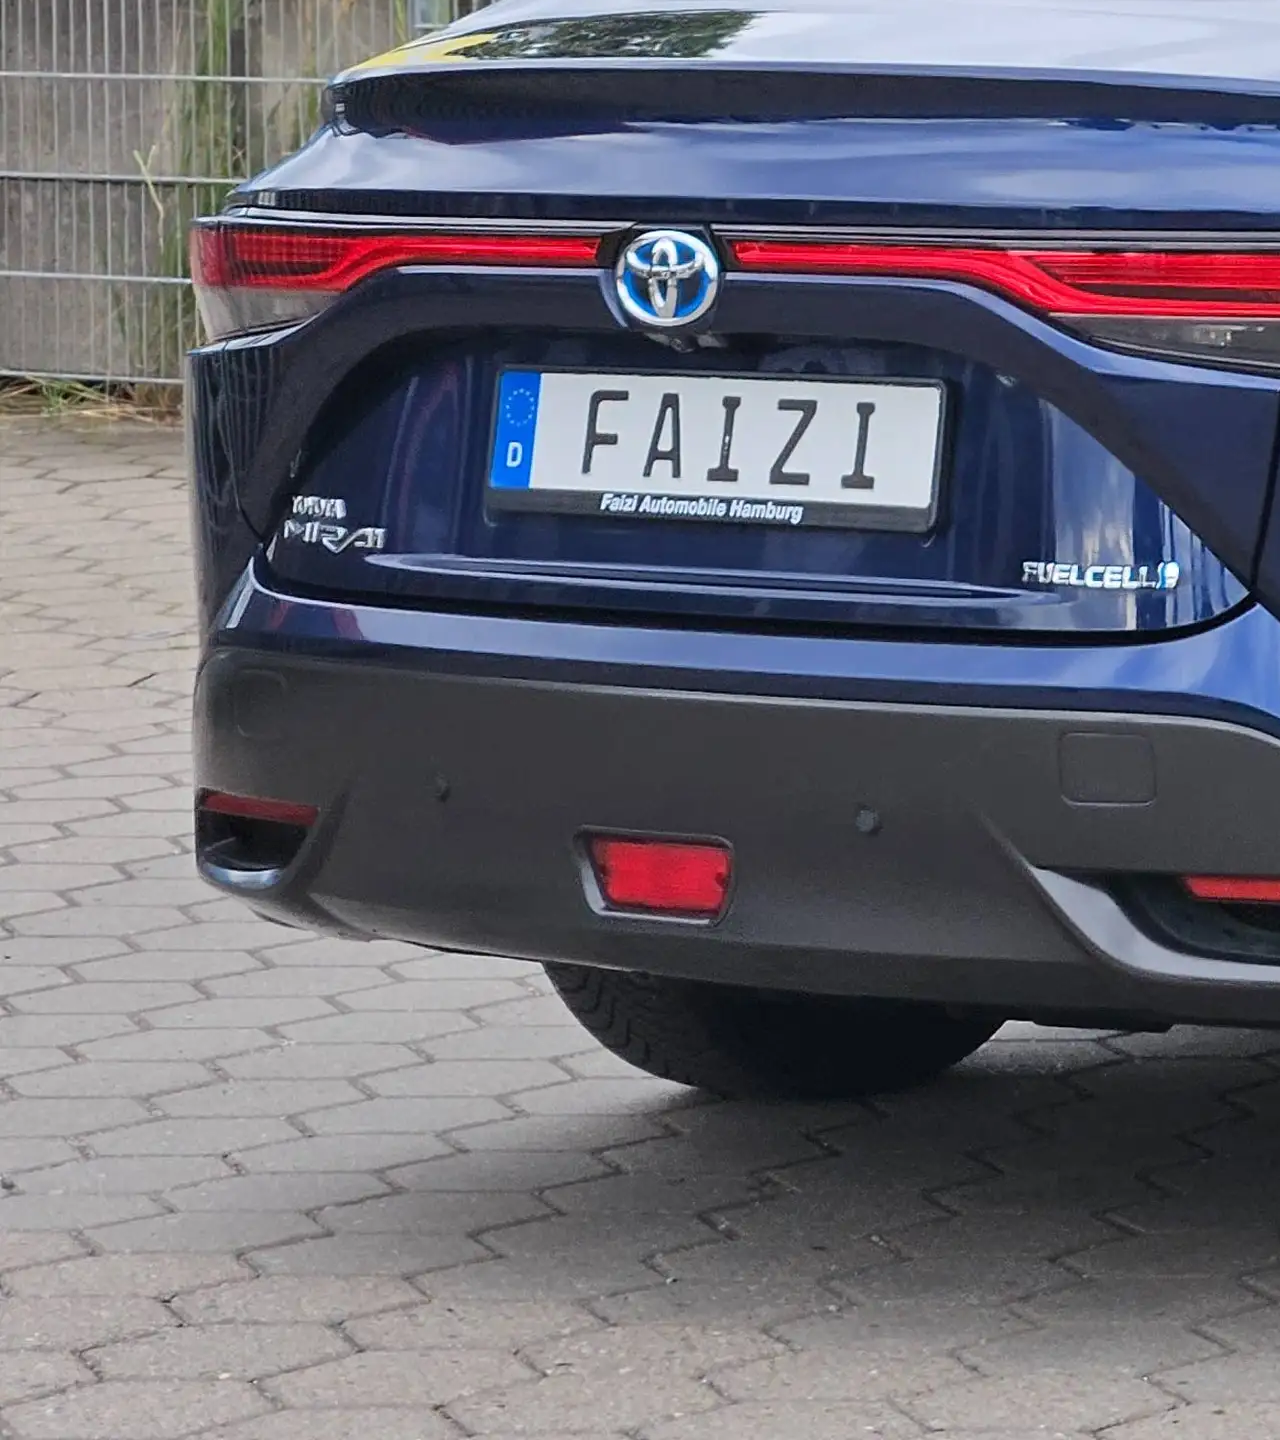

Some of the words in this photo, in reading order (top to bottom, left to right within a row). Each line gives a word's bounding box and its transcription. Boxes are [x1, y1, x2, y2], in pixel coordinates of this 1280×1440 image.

[506, 442, 522, 468] D
[582, 389, 876, 489] FAIZI
[600, 493, 637, 512] Faizi
[639, 495, 727, 517] Automobile
[729, 499, 804, 525] Hamburg
